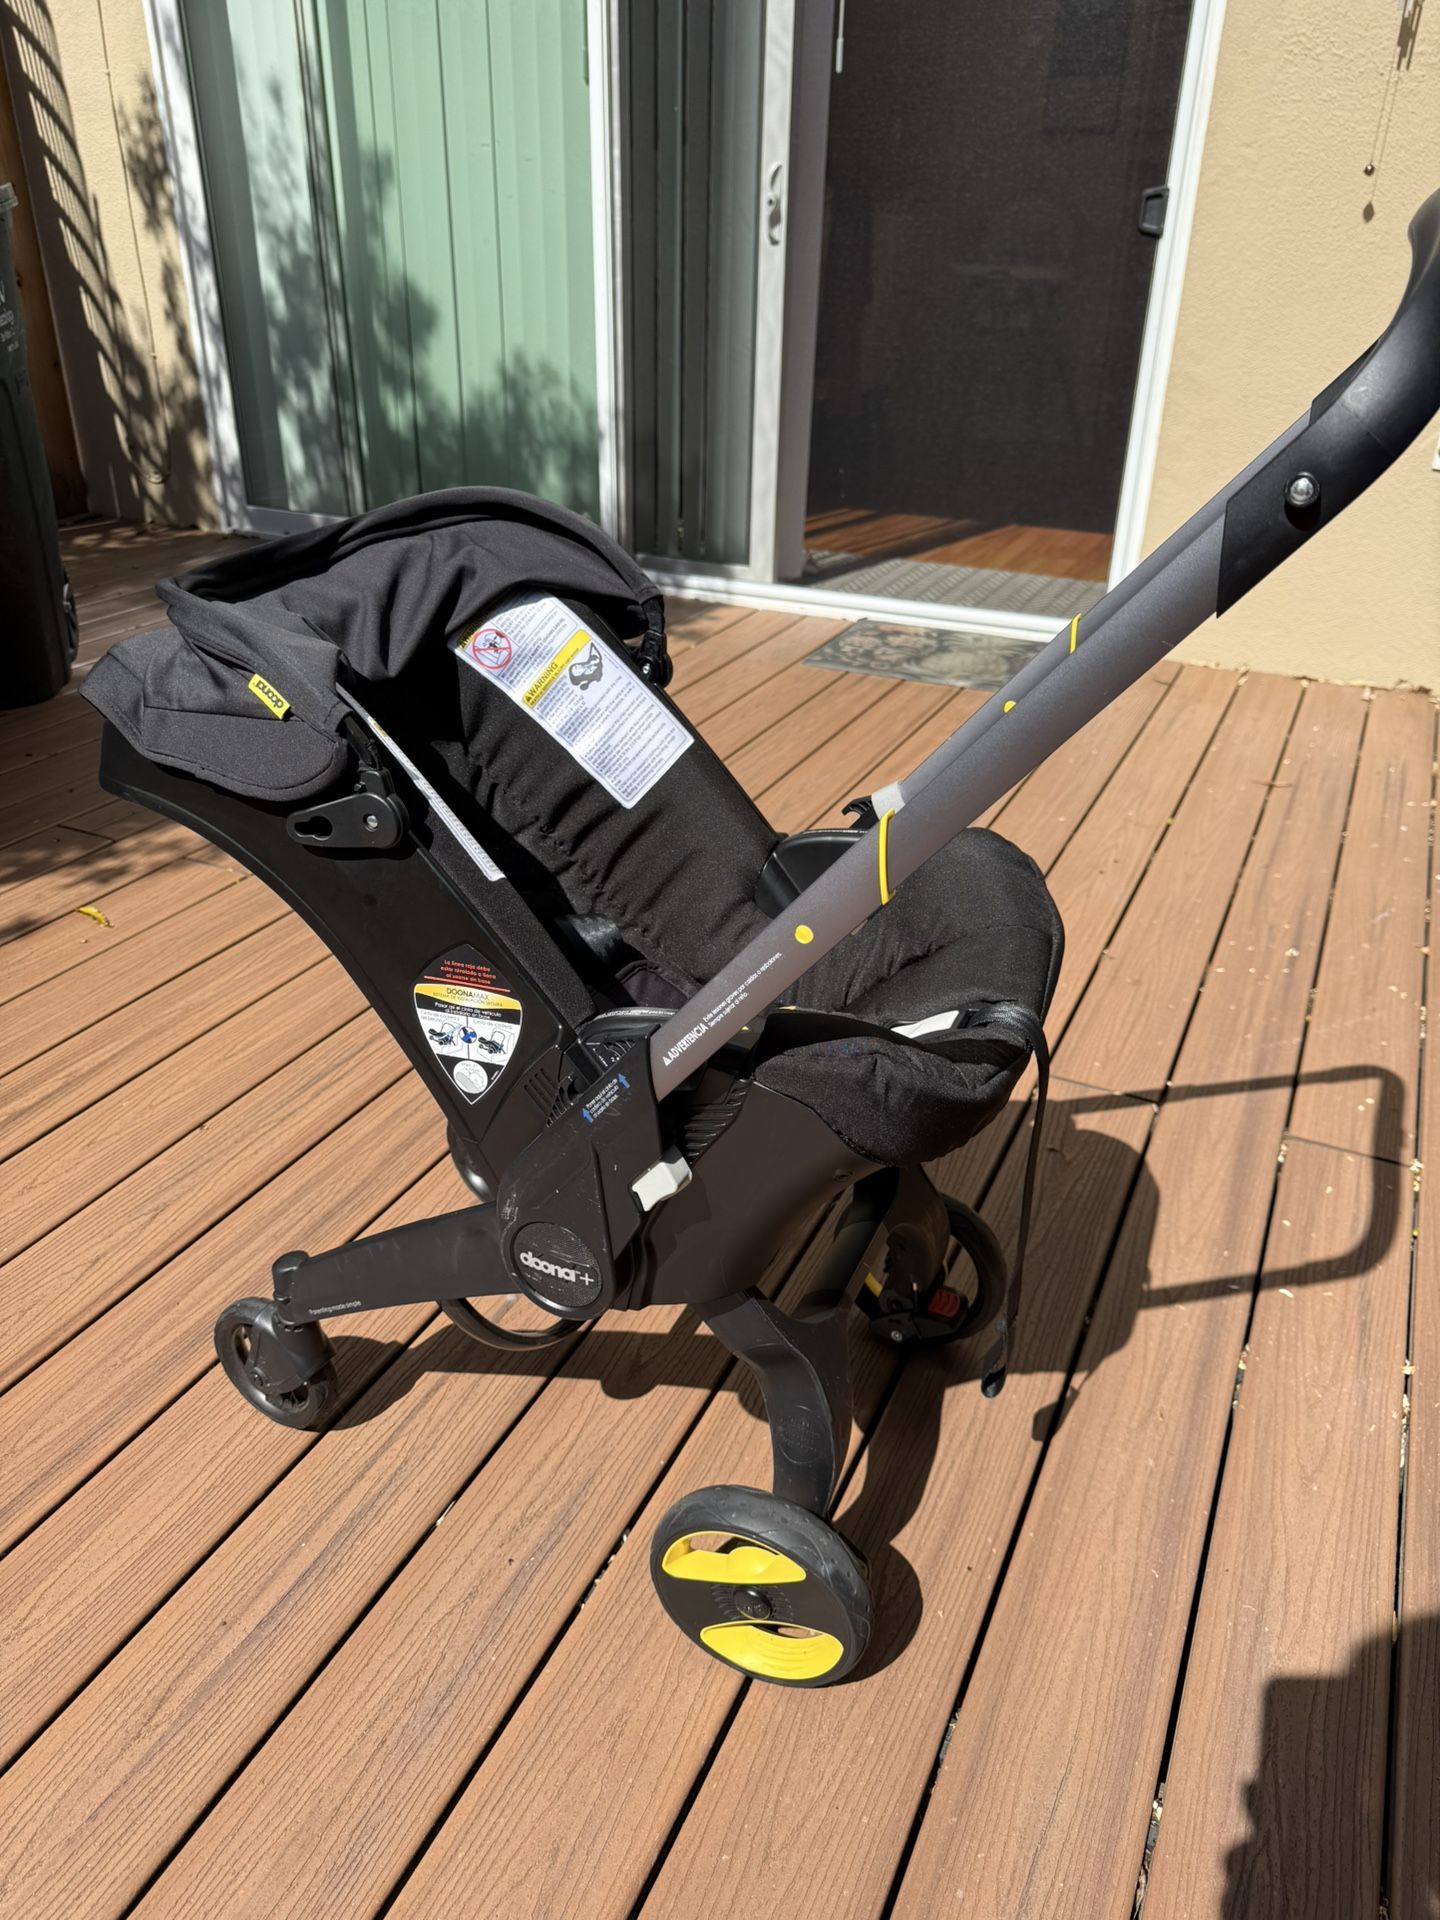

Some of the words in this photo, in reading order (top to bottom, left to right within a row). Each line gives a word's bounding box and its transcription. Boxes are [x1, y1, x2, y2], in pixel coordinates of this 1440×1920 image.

[256, 679, 284, 708] doona
[526, 662, 559, 696] WARNING
[445, 987, 490, 1000] DOONAMAX
[666, 1020, 709, 1060] ADVERTENCIA
